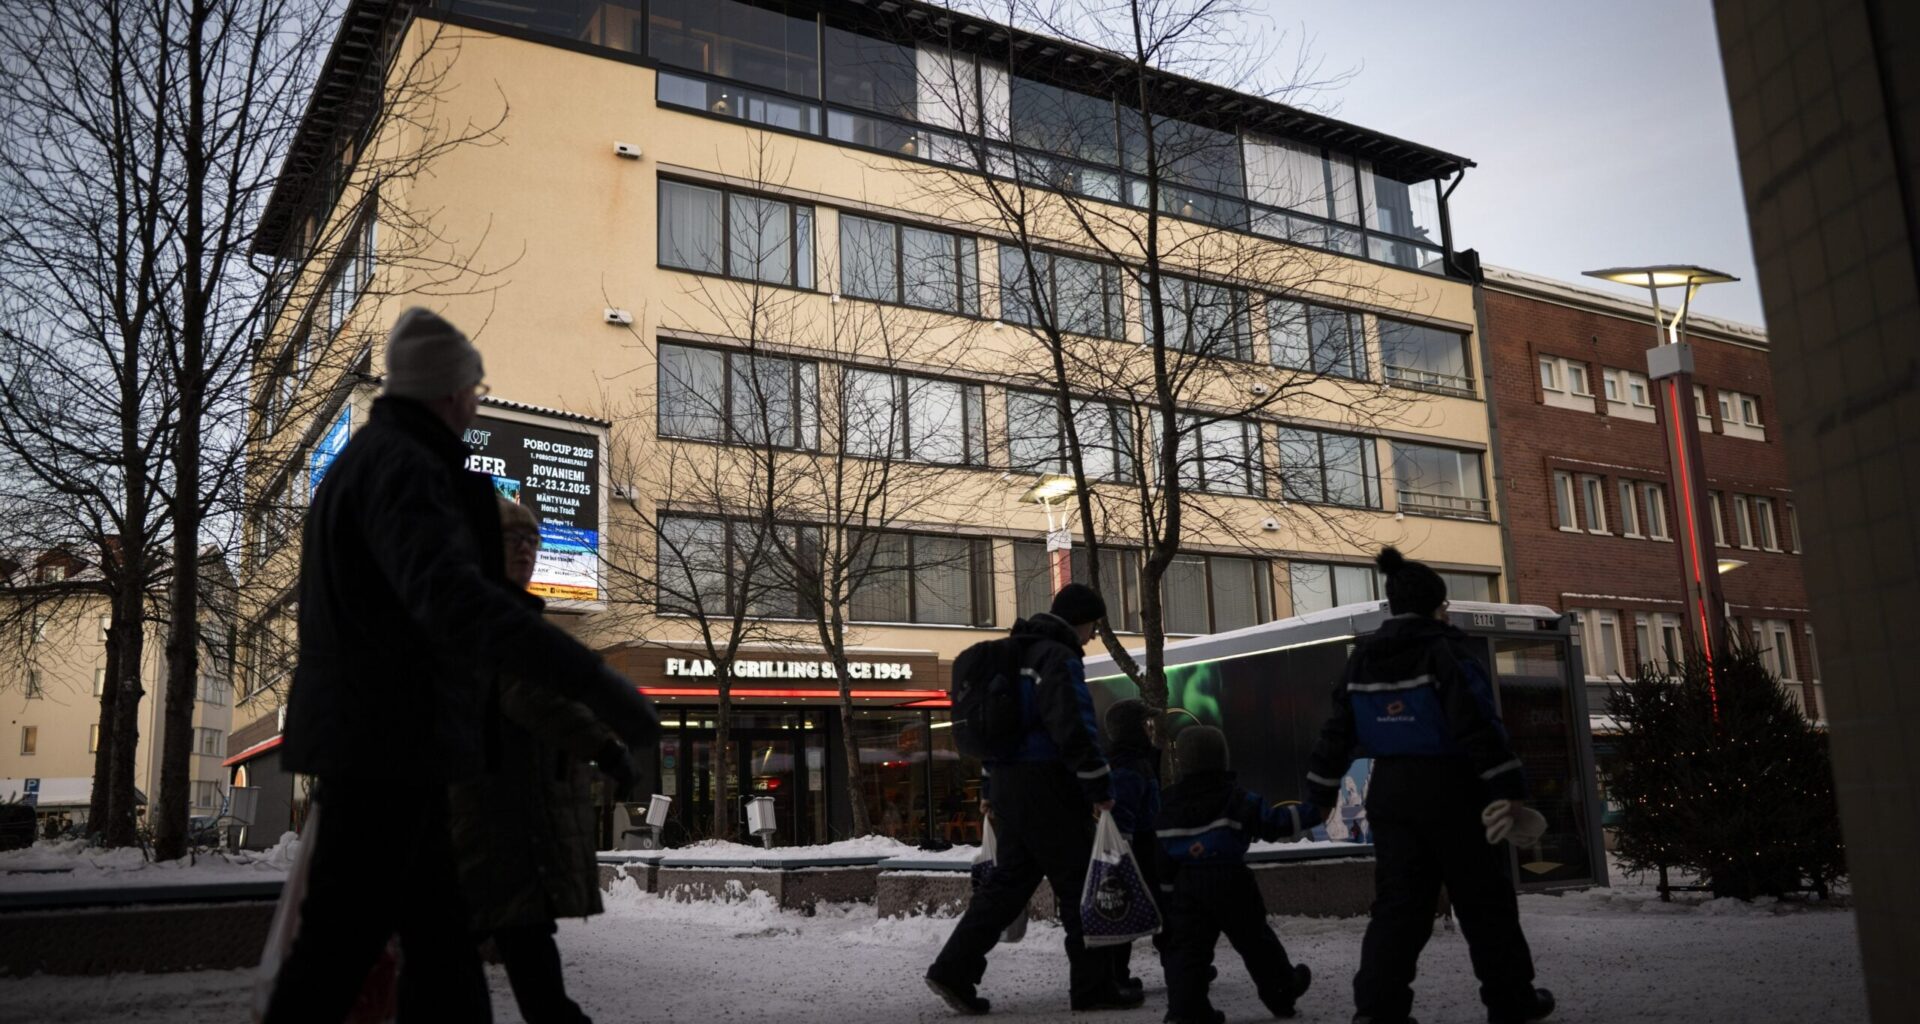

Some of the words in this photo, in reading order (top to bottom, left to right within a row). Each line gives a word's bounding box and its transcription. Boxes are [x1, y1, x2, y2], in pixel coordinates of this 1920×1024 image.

[523, 438, 551, 452] PORO
[552, 443, 572, 455] CUP
[573, 446, 594, 459] 2025
[533, 464, 585, 482] ROVANIEMI
[526, 476, 591, 495] 22.-23.2.2025
[536, 492, 580, 507] MÄNTYVAARA
[541, 504, 559, 513] Horse
[559, 506, 576, 516] Track
[665, 657, 731, 678] FLAM
[733, 659, 820, 679] GRILLING
[821, 661, 873, 680] SICE
[873, 662, 913, 680] 1954
[27, 780, 37, 792] P
